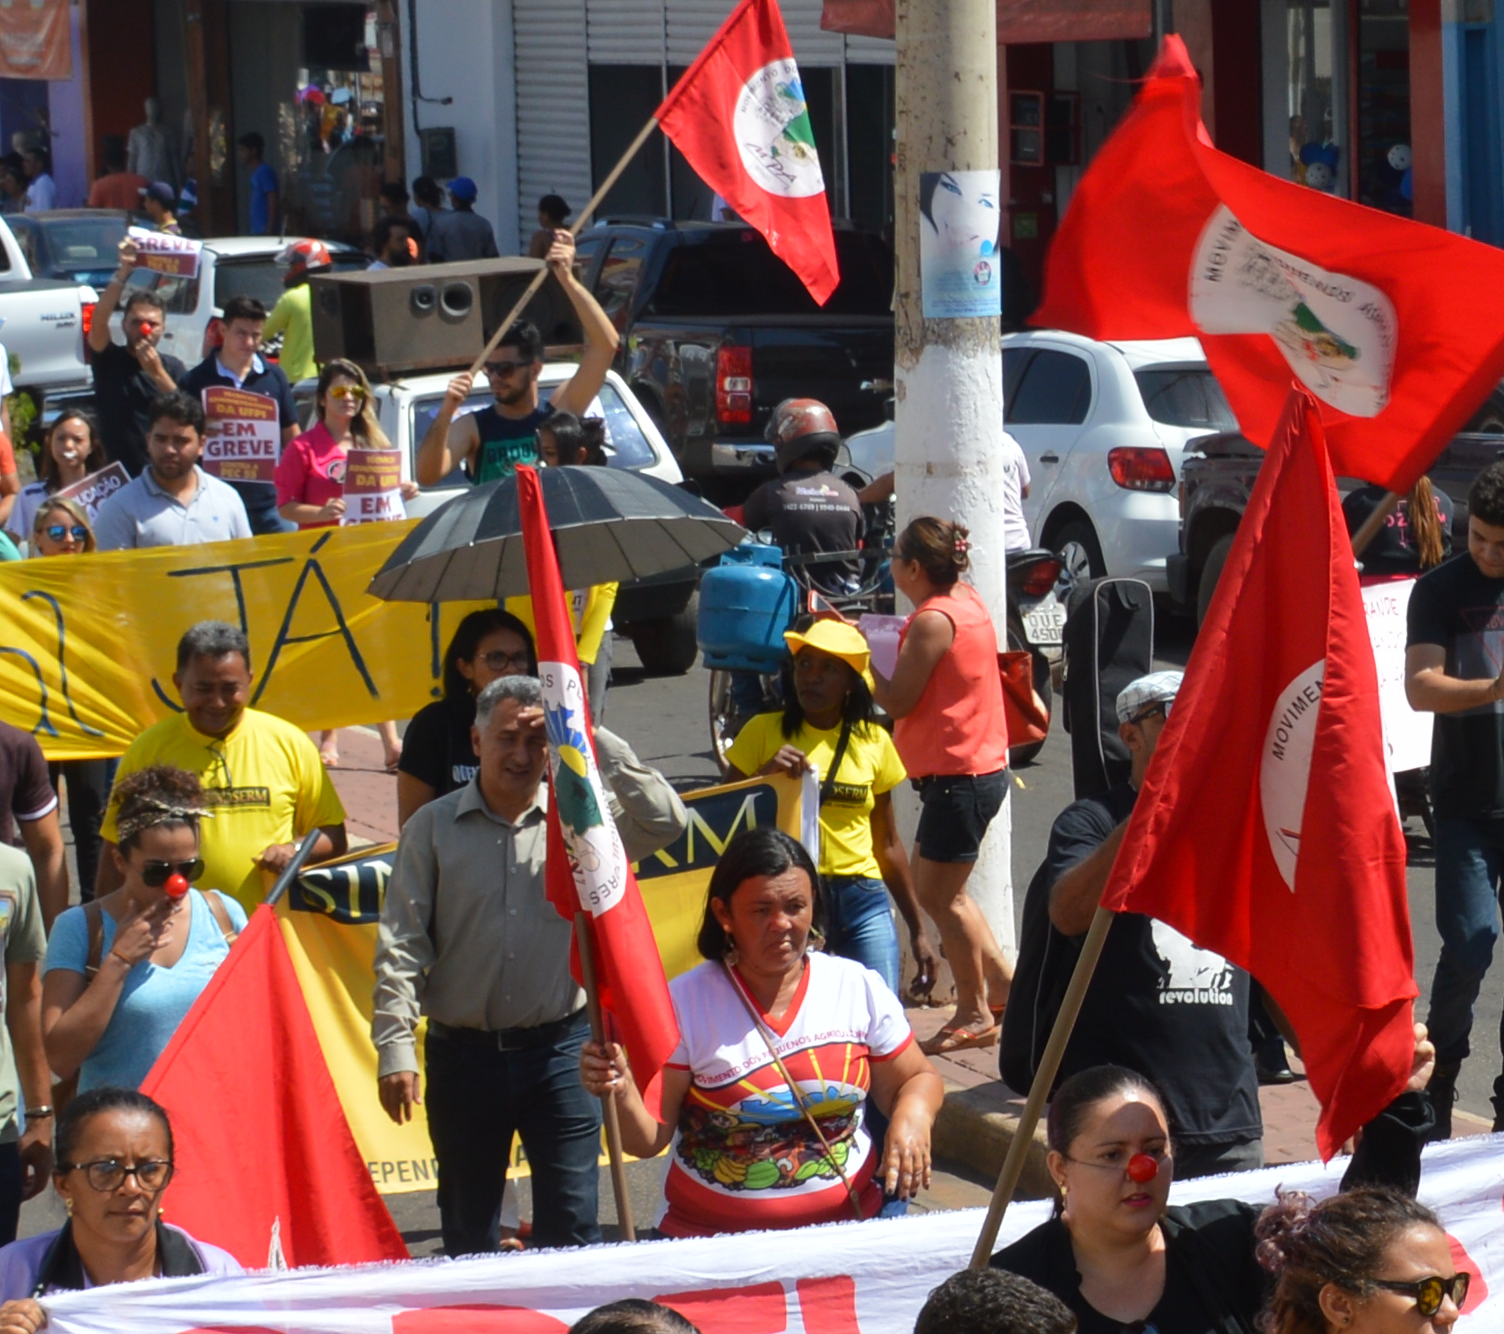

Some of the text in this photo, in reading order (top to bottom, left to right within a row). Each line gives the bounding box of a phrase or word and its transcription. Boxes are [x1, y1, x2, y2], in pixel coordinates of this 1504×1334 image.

[222, 421, 256, 437] EM
[207, 439, 275, 458] GREVE
[360, 497, 392, 515] EM
[1158, 988, 1234, 1006] revolution
